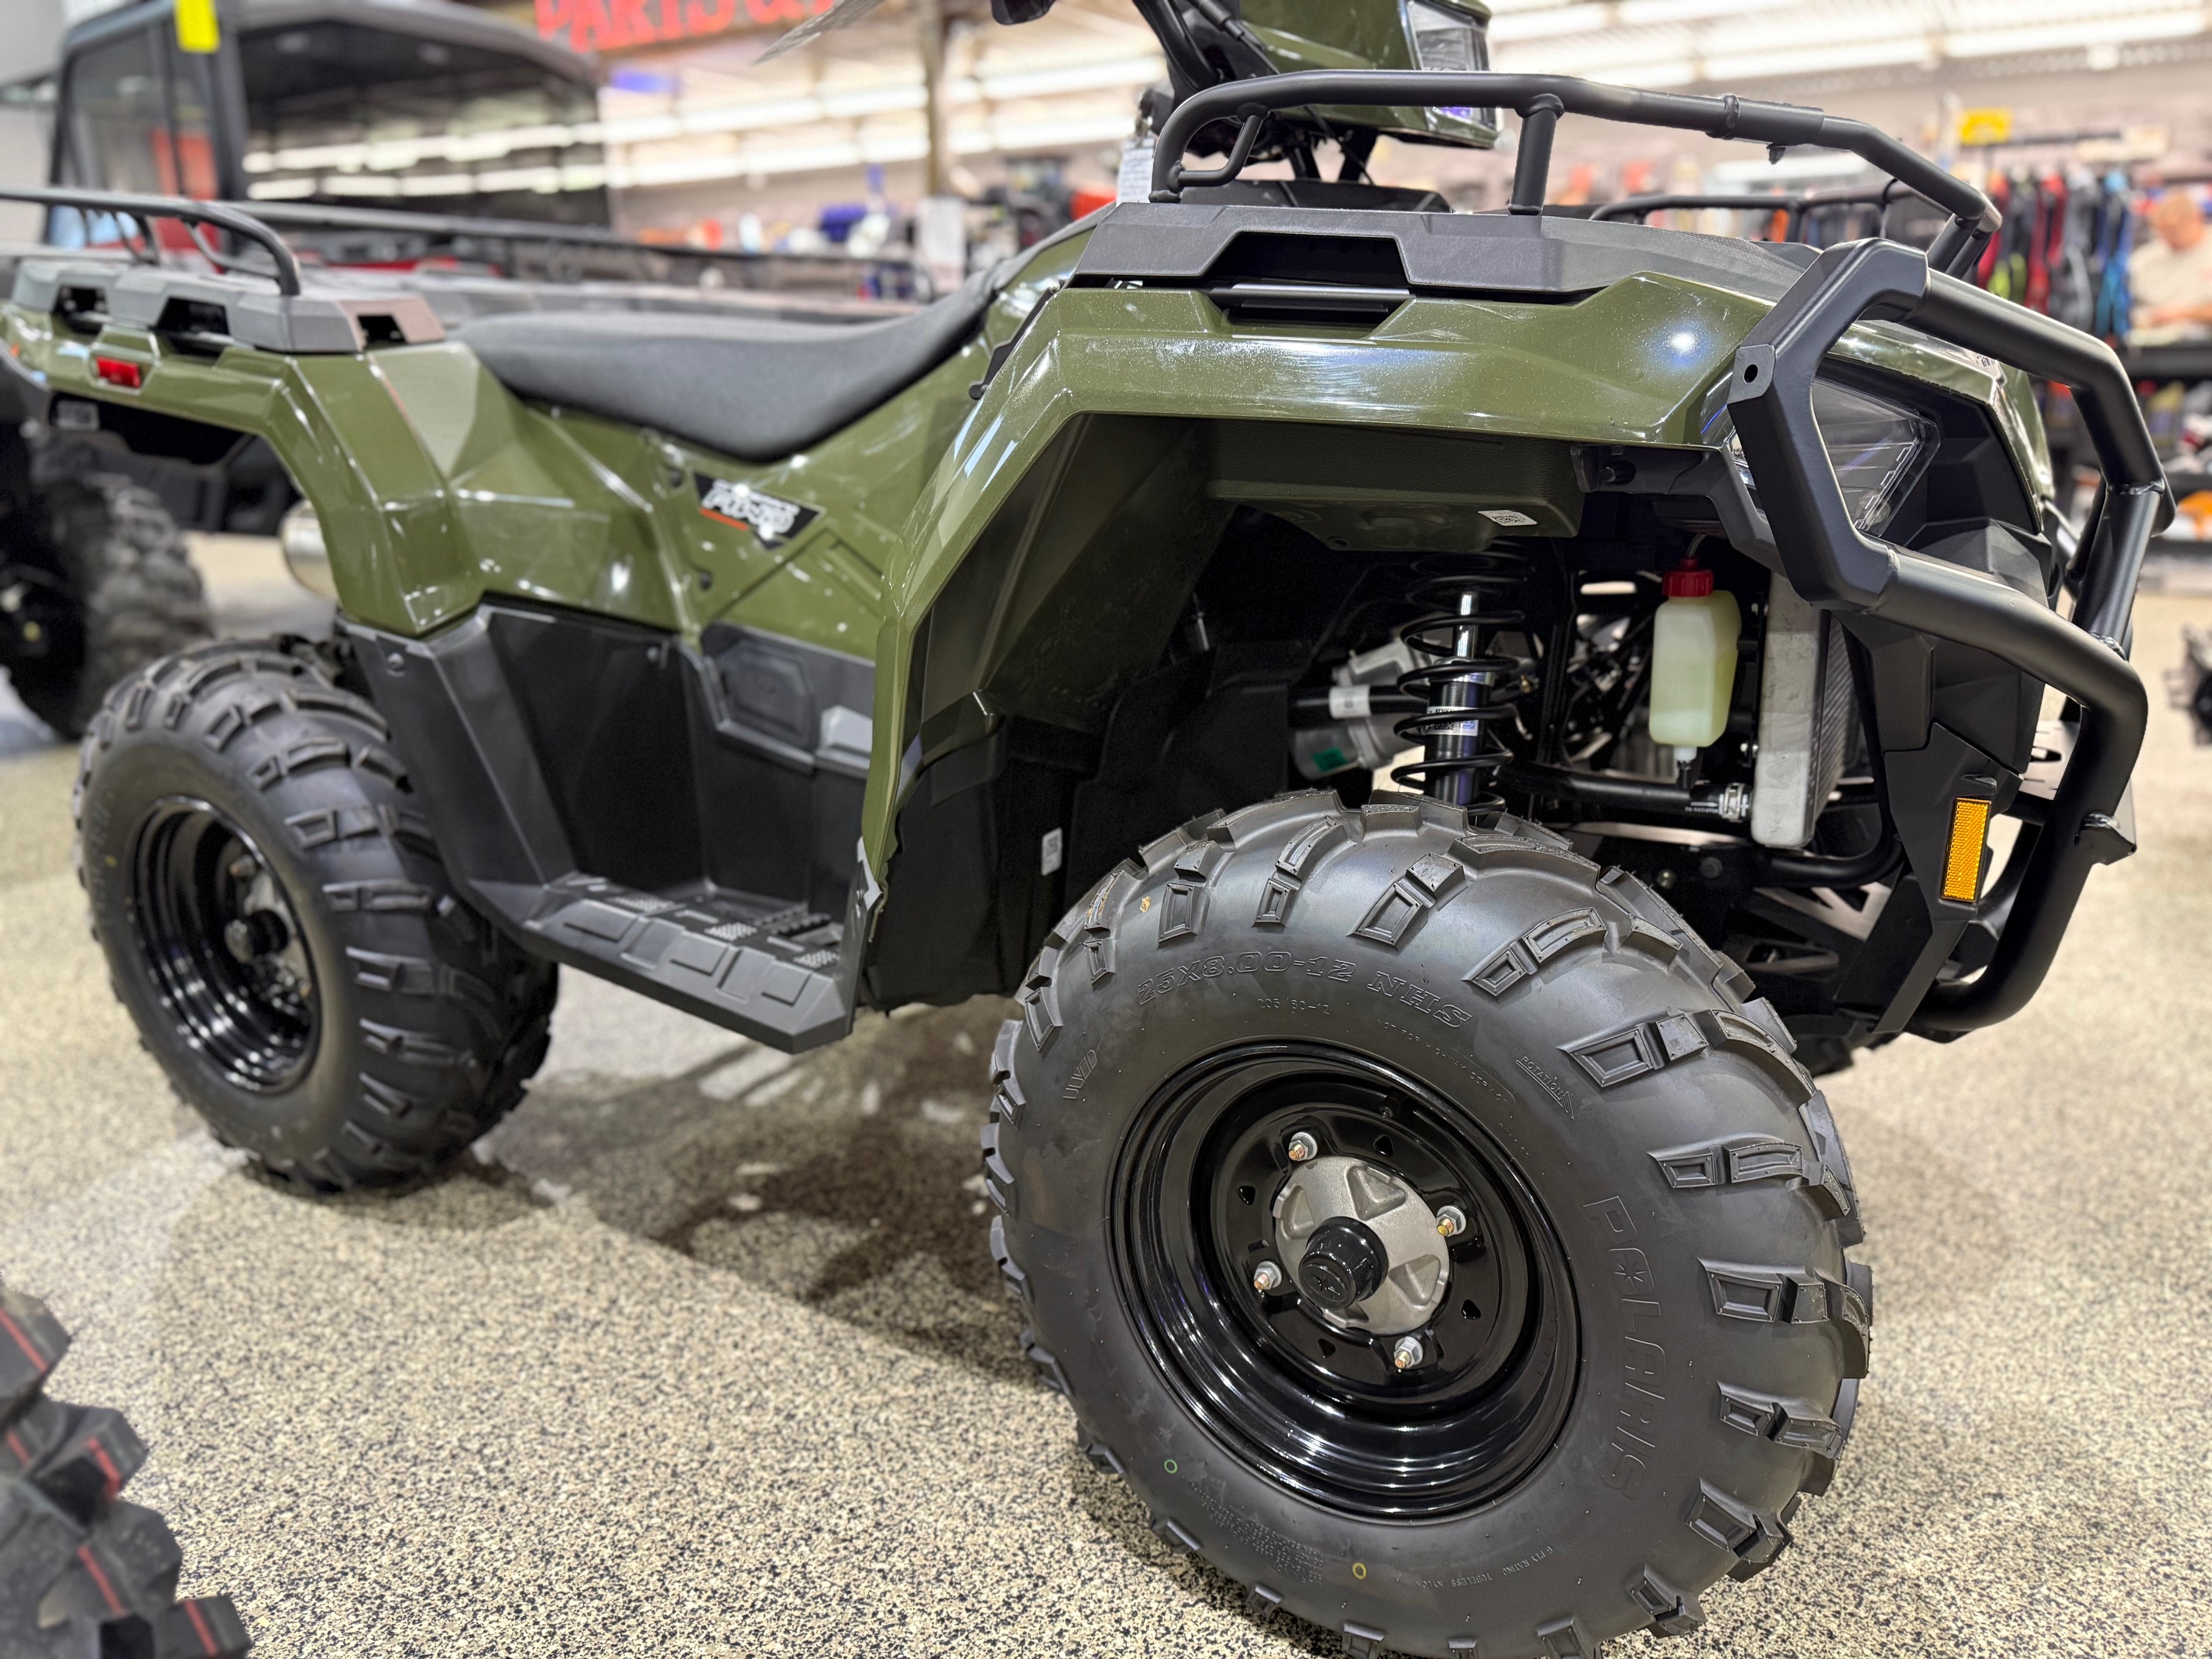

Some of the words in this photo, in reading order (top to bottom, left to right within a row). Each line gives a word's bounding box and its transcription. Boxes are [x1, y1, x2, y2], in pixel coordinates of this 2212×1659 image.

[1137, 951, 1356, 1005] 25X8.00-12
[1366, 970, 1472, 1028] NHS
[1520, 1056, 1564, 1097] ROTATION
[1582, 1196, 1666, 1501] POLARIS
[1451, 1572, 1493, 1587] TUBELESS
[1502, 1558, 1530, 1576] RATING
